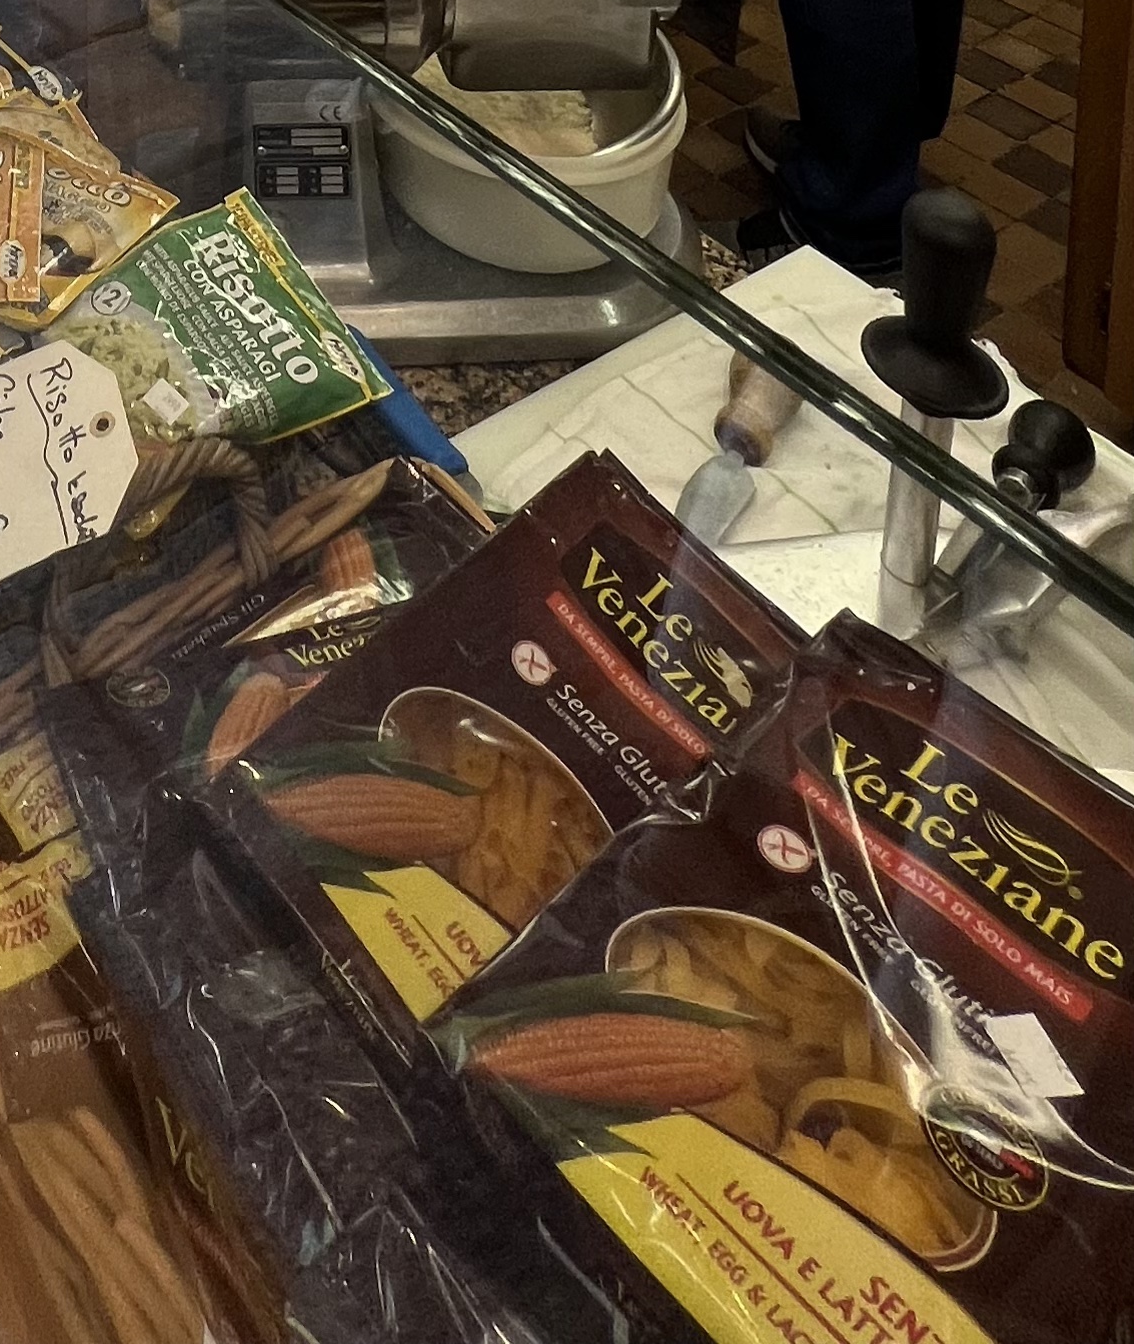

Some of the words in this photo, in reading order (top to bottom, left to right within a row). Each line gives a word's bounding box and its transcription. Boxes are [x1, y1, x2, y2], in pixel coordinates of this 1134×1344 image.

[183, 259, 215, 296] CON
[212, 300, 281, 383] ASPARAGI
[200, 231, 319, 384] Risotto
[41, 358, 86, 463] Risotto
[635, 572, 695, 644] Le
[555, 602, 576, 624] DA
[617, 672, 655, 709] PASTA
[655, 708, 671, 723] DI
[669, 722, 706, 756] SOLO
[544, 696, 582, 734] GLUTEN
[579, 731, 605, 755] FREE
[612, 763, 653, 806] GLUTEN
[554, 682, 621, 746] Senza
[616, 741, 669, 795] Glut
[898, 738, 981, 818] Le
[829, 733, 1125, 982] Veneziane
[443, 919, 488, 970] UOV
[823, 870, 909, 956] Senza
[896, 860, 950, 906] PASTA
[948, 900, 972, 922] DI
[971, 919, 1025, 965] SOLO
[1022, 961, 1074, 1004] MAIS
[935, 1130, 1024, 1204] GRASSI
[703, 1240, 749, 1285] EGG
[743, 1282, 767, 1307] &
[719, 1179, 797, 1261] UOVA
[795, 1255, 821, 1282] E
[857, 1272, 943, 1344] SEN
